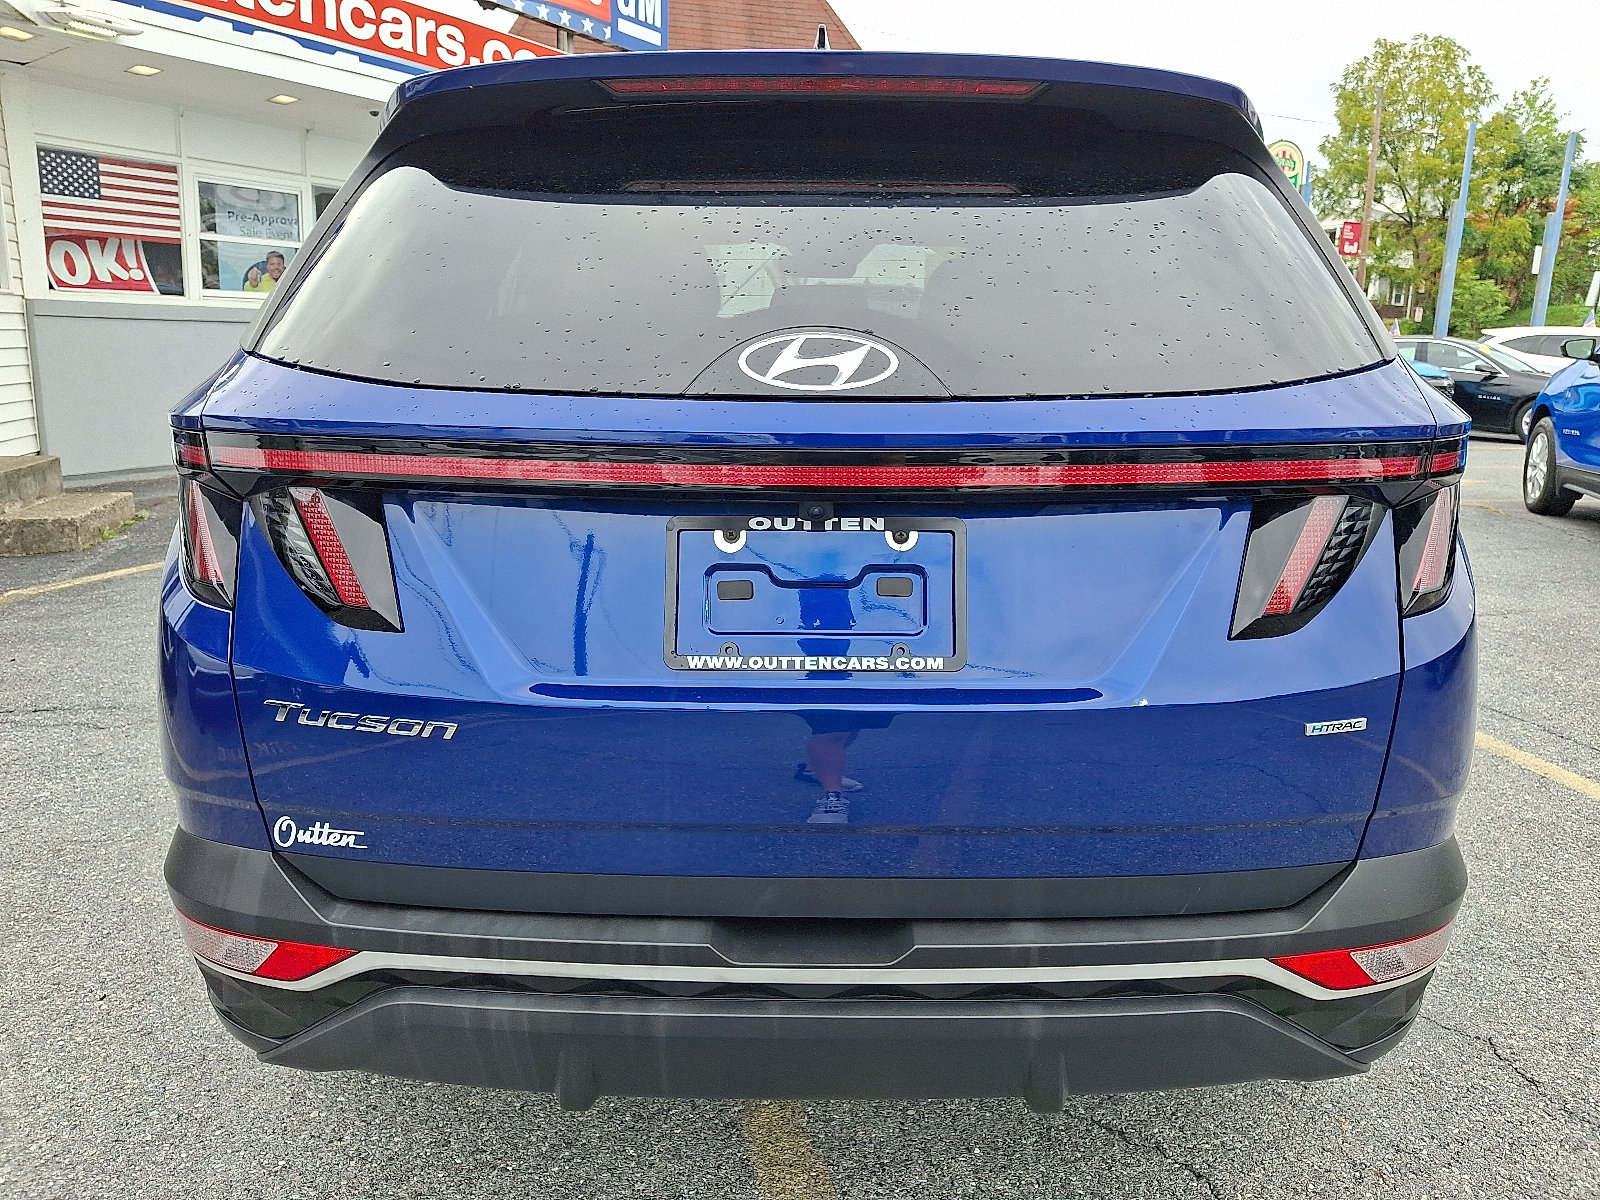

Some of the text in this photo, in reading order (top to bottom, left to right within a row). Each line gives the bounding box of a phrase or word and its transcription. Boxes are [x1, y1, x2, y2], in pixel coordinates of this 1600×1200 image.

[219, 0, 537, 67] encars.c
[240, 226, 293, 240] Sale Event
[49, 238, 145, 286] OK!
[687, 655, 944, 670] WWW.OUTTENCARS.COM
[1311, 720, 1363, 734] HTRAC
[274, 815, 367, 848] Outten
